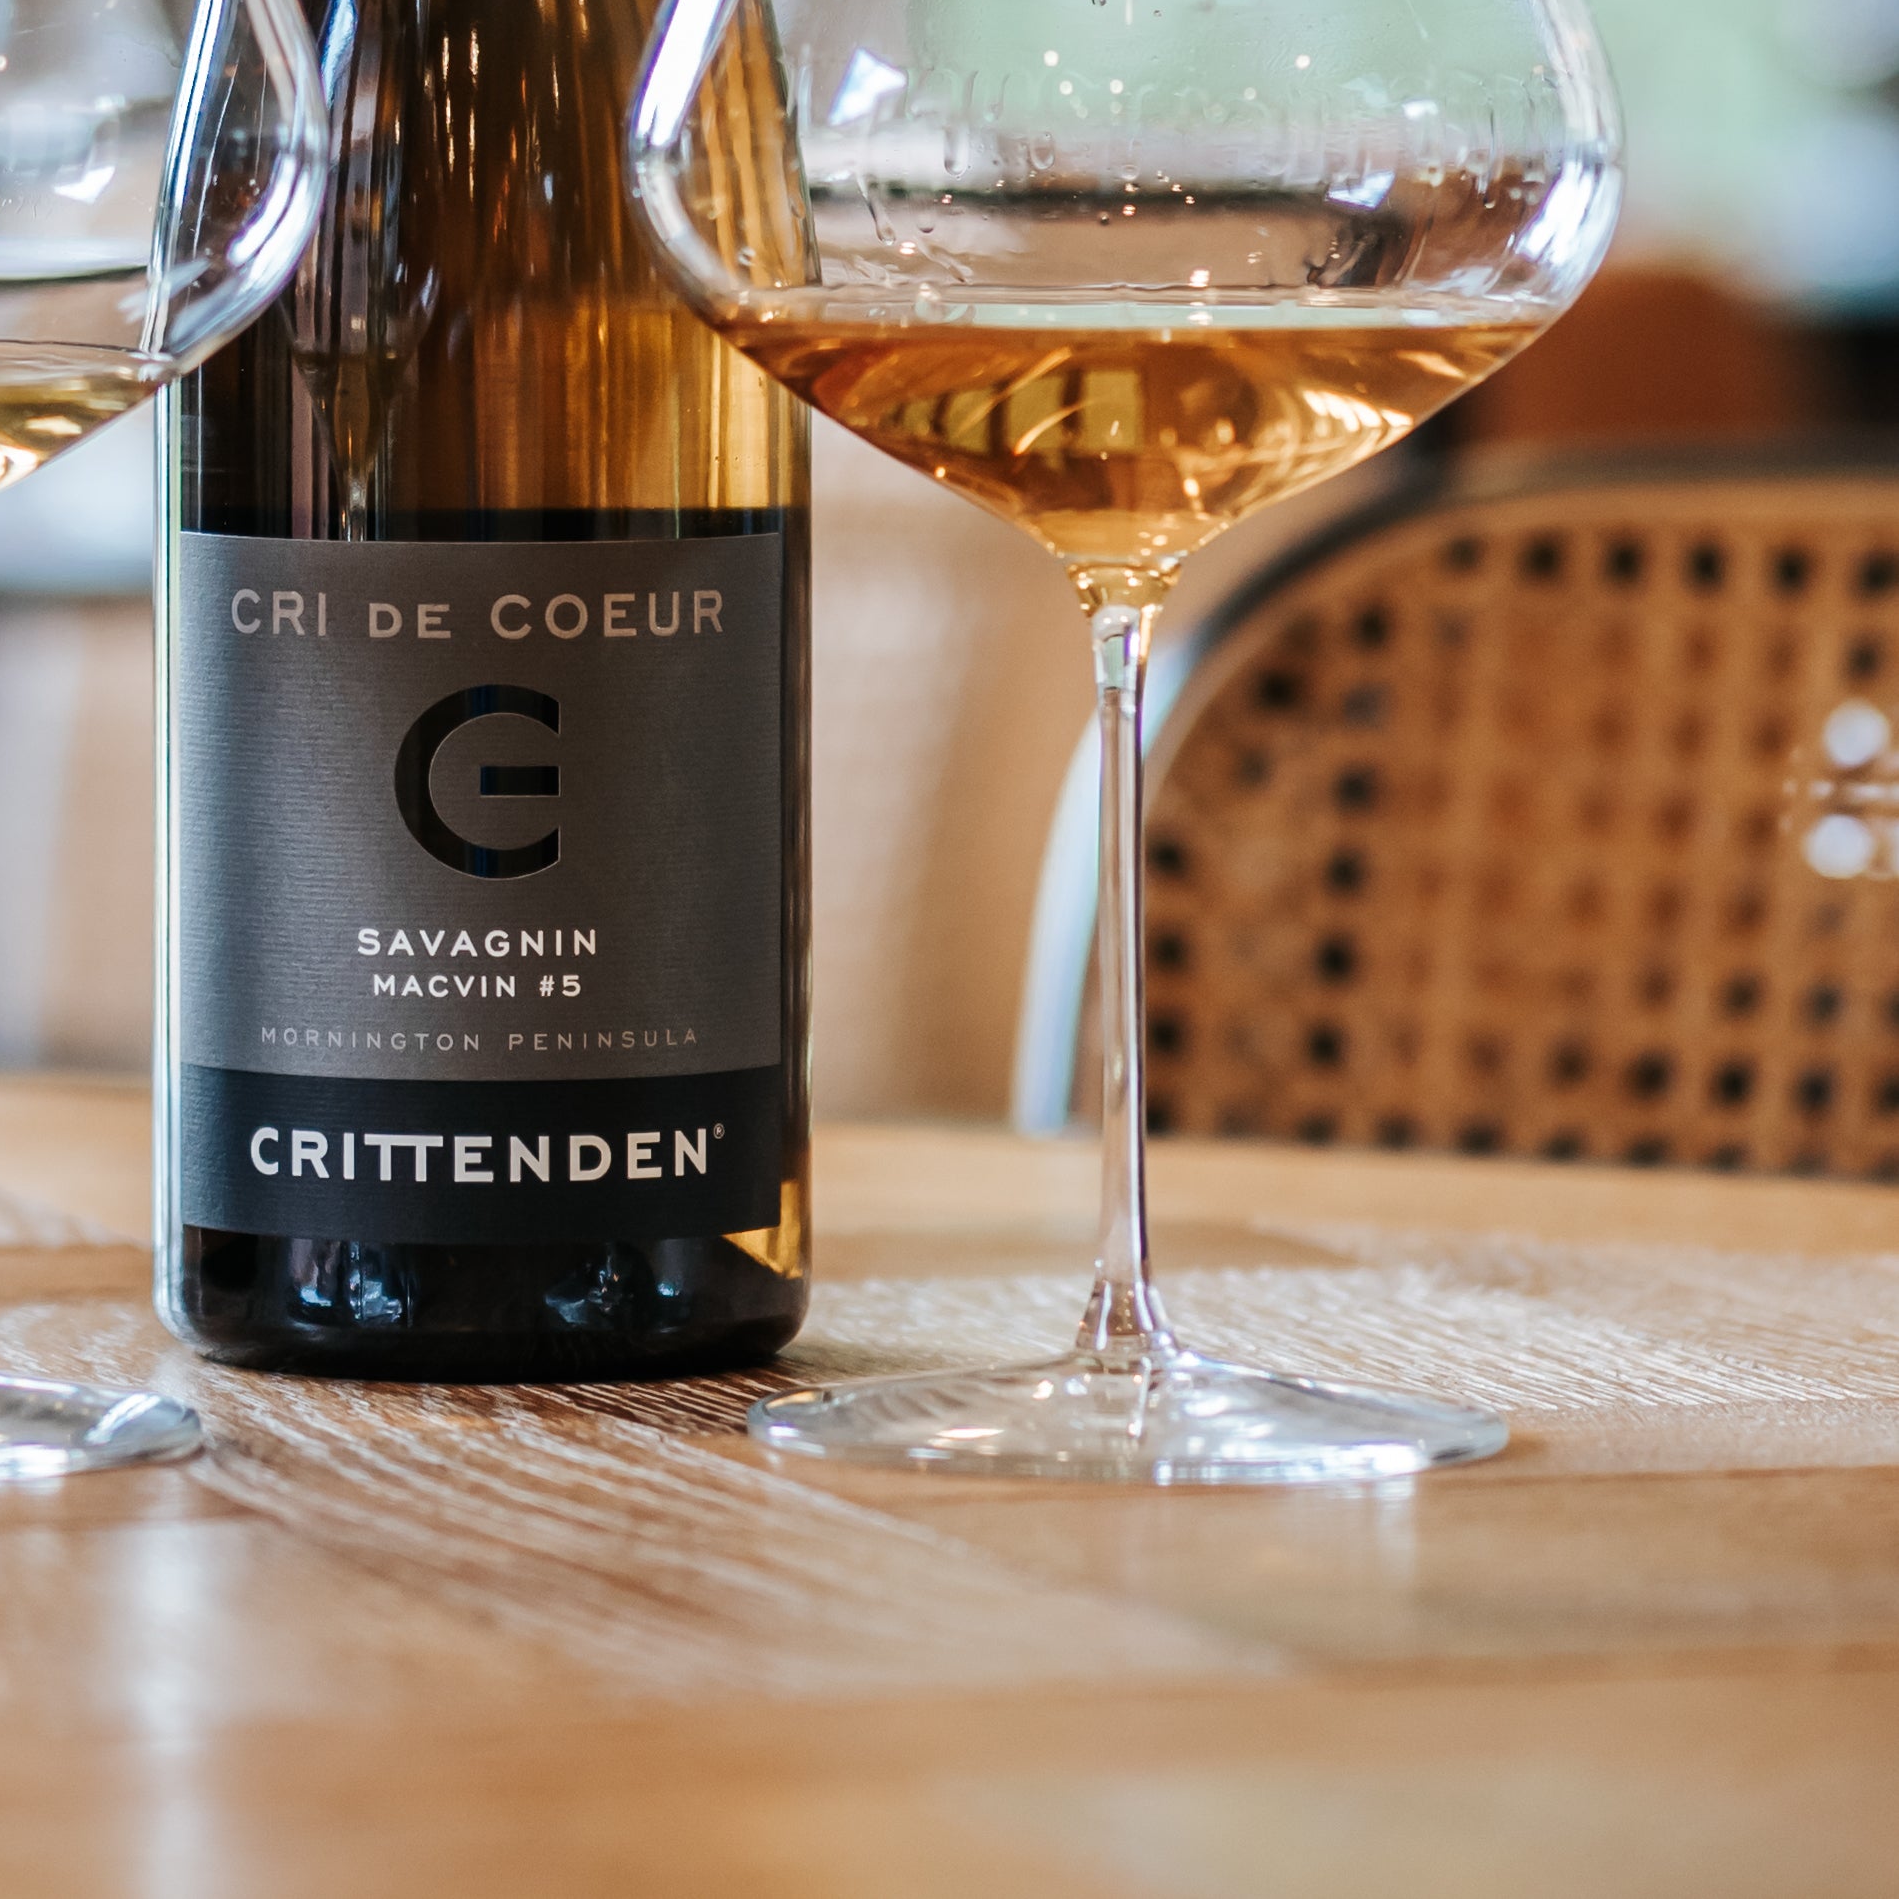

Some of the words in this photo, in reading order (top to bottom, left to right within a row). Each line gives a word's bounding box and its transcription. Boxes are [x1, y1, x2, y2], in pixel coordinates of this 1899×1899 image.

[230, 588, 327, 637] CRI
[368, 602, 452, 639] DE
[490, 589, 723, 640] COEUR
[357, 927, 596, 958] SAVAGNIN
[373, 973, 516, 998] MACVIN
[539, 974, 582, 998] #5
[261, 1026, 480, 1052] MORNINGTON
[507, 1027, 697, 1052] PENINSULA
